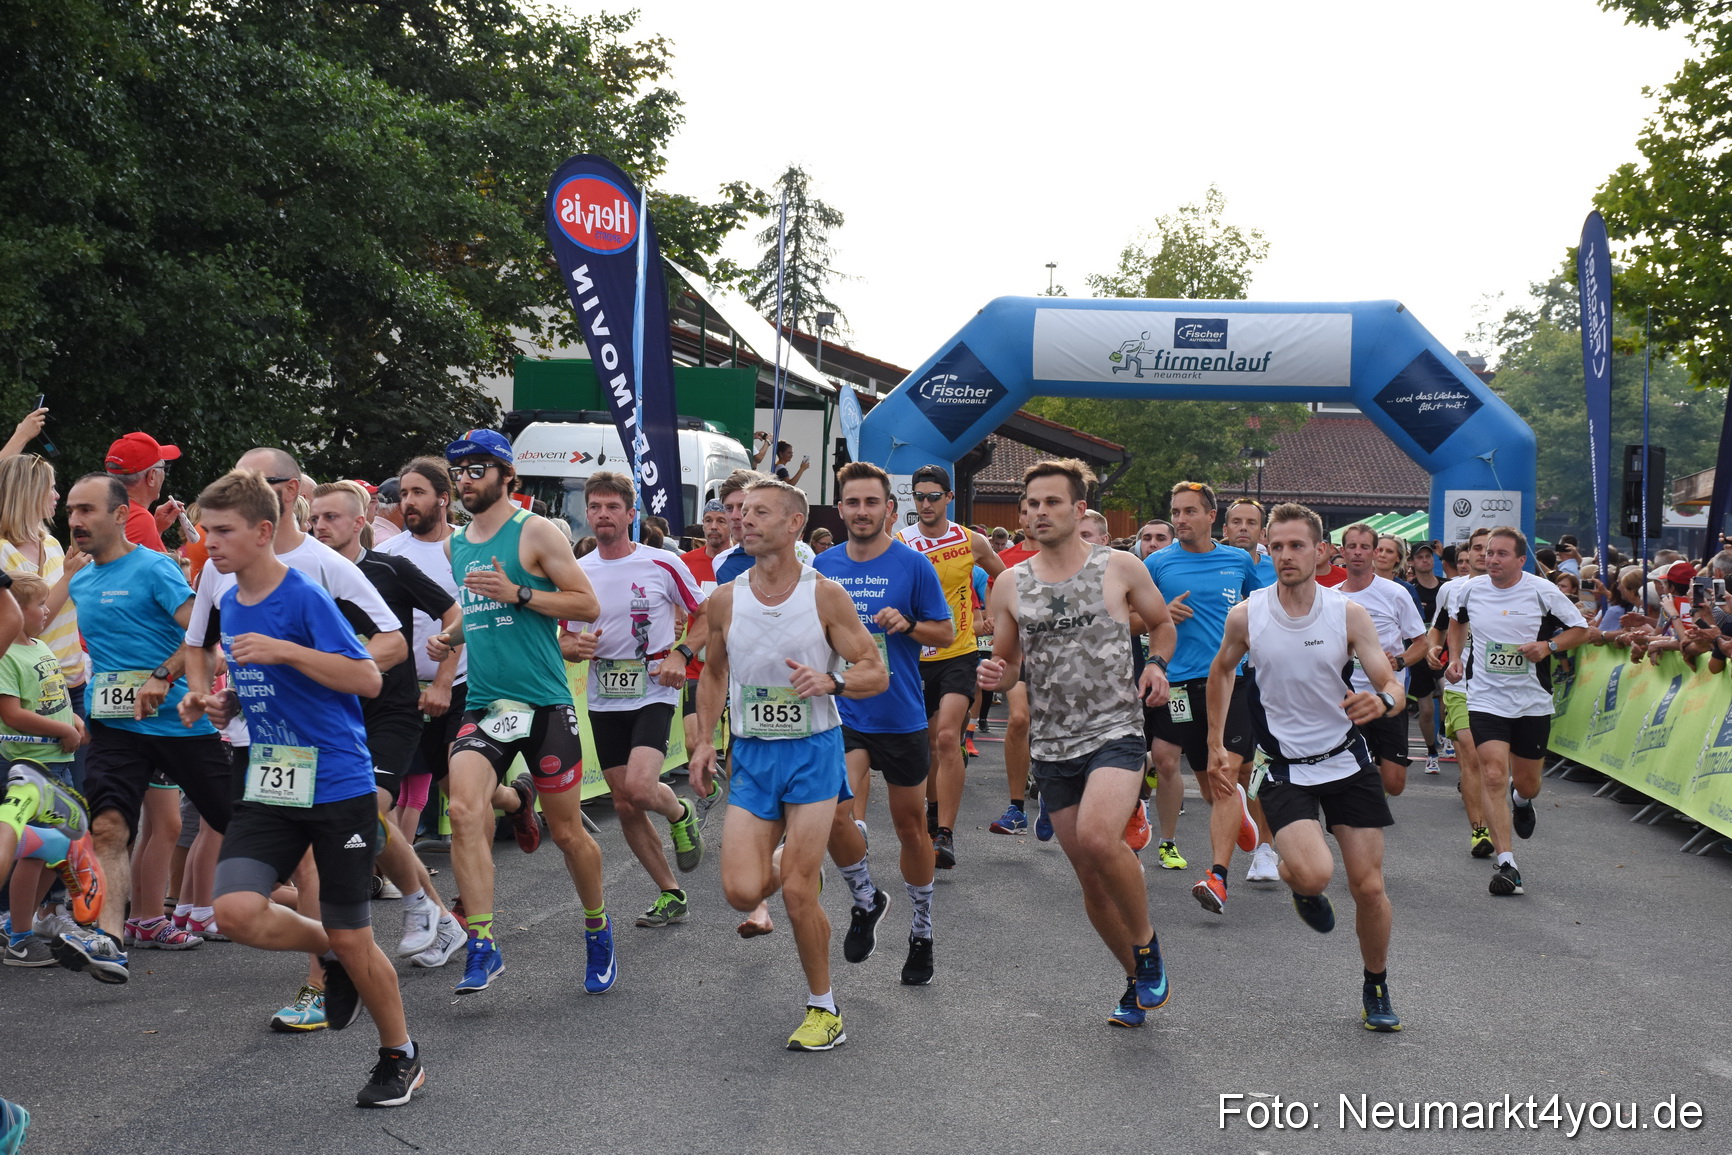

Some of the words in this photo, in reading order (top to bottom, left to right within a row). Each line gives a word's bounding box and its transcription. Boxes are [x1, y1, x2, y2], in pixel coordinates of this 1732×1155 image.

[1185, 329, 1225, 339] Fischer
[1154, 349, 1273, 372] firmenlauf
[1153, 371, 1202, 379] neumarkt
[931, 384, 993, 398] Fischer
[1415, 391, 1433, 401] das
[936, 397, 987, 405] AUTOMOBILE
[517, 450, 567, 461] abavent
[942, 545, 971, 561] BÖGL
[854, 577, 864, 585] es
[865, 574, 889, 585] beim
[494, 615, 513, 624] TAO
[1025, 614, 1097, 636] SAYSKY
[1304, 639, 1325, 647] Stefan
[1490, 653, 1523, 666] 2370
[602, 672, 639, 687] 1787
[751, 704, 802, 723] 1853
[491, 715, 518, 734] 9132
[260, 766, 296, 789] 731
